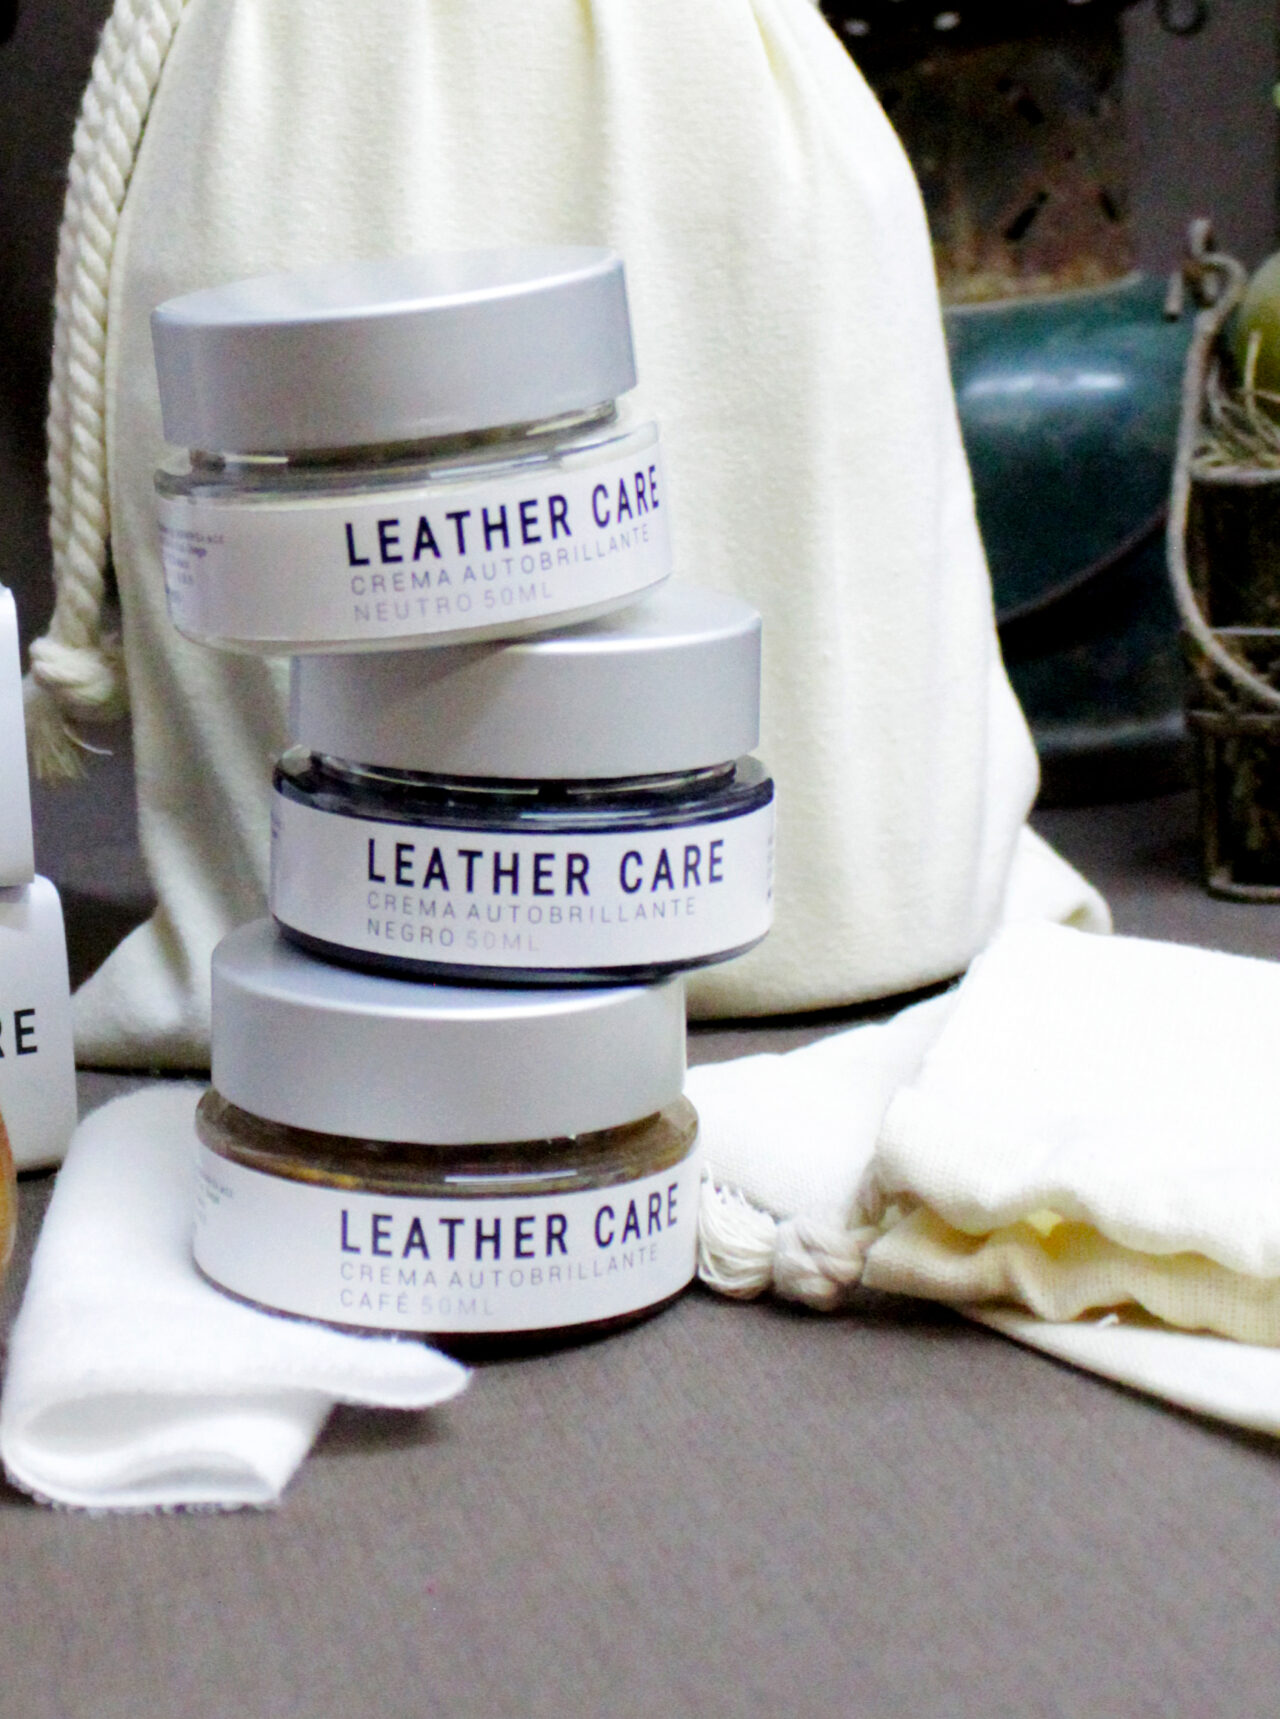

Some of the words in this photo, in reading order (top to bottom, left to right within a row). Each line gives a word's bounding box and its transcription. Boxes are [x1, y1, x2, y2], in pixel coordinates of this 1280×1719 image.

[345, 494, 572, 566] LEATHER
[591, 464, 660, 528] CARE
[351, 567, 452, 597] CREMA
[463, 523, 650, 583] AUTOBRILLANTE
[354, 594, 472, 623] NEUTRO
[485, 582, 552, 610] 50ML
[368, 838, 590, 896] LEATHER
[619, 839, 724, 894] CARE
[368, 891, 455, 919] CREMA
[467, 896, 696, 924] AUTOBRILLANTE
[368, 918, 455, 947] NEGRO
[466, 930, 540, 952] 50ML
[340, 1210, 569, 1261] LEATHER
[594, 1182, 678, 1247] CARE
[340, 1262, 438, 1288] CREMA
[448, 1243, 658, 1289] AUTOBRILLANTE
[420, 1294, 494, 1316] 50ML
